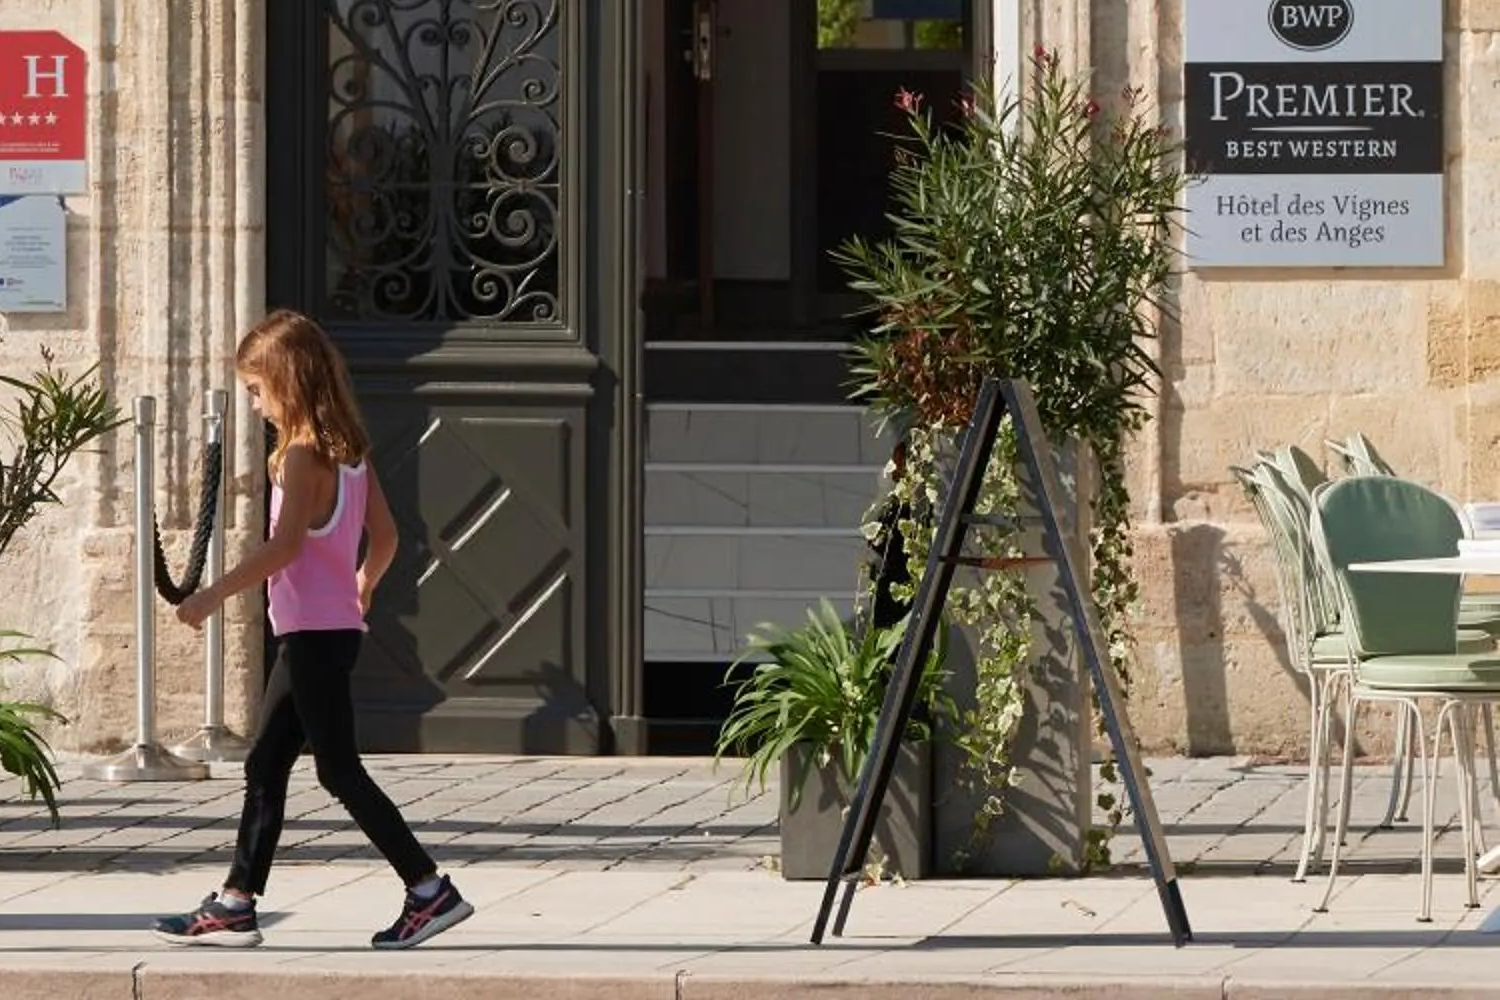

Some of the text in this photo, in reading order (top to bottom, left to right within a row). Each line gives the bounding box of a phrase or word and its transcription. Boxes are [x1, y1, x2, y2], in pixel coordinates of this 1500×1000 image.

[1281, 5, 1343, 28] BWP
[22, 55, 69, 98] H
[1226, 139, 1397, 158] BEST WESTERN
[1216, 193, 1410, 221] Hôtel des Vignes
[1240, 220, 1385, 247] et des Anges
